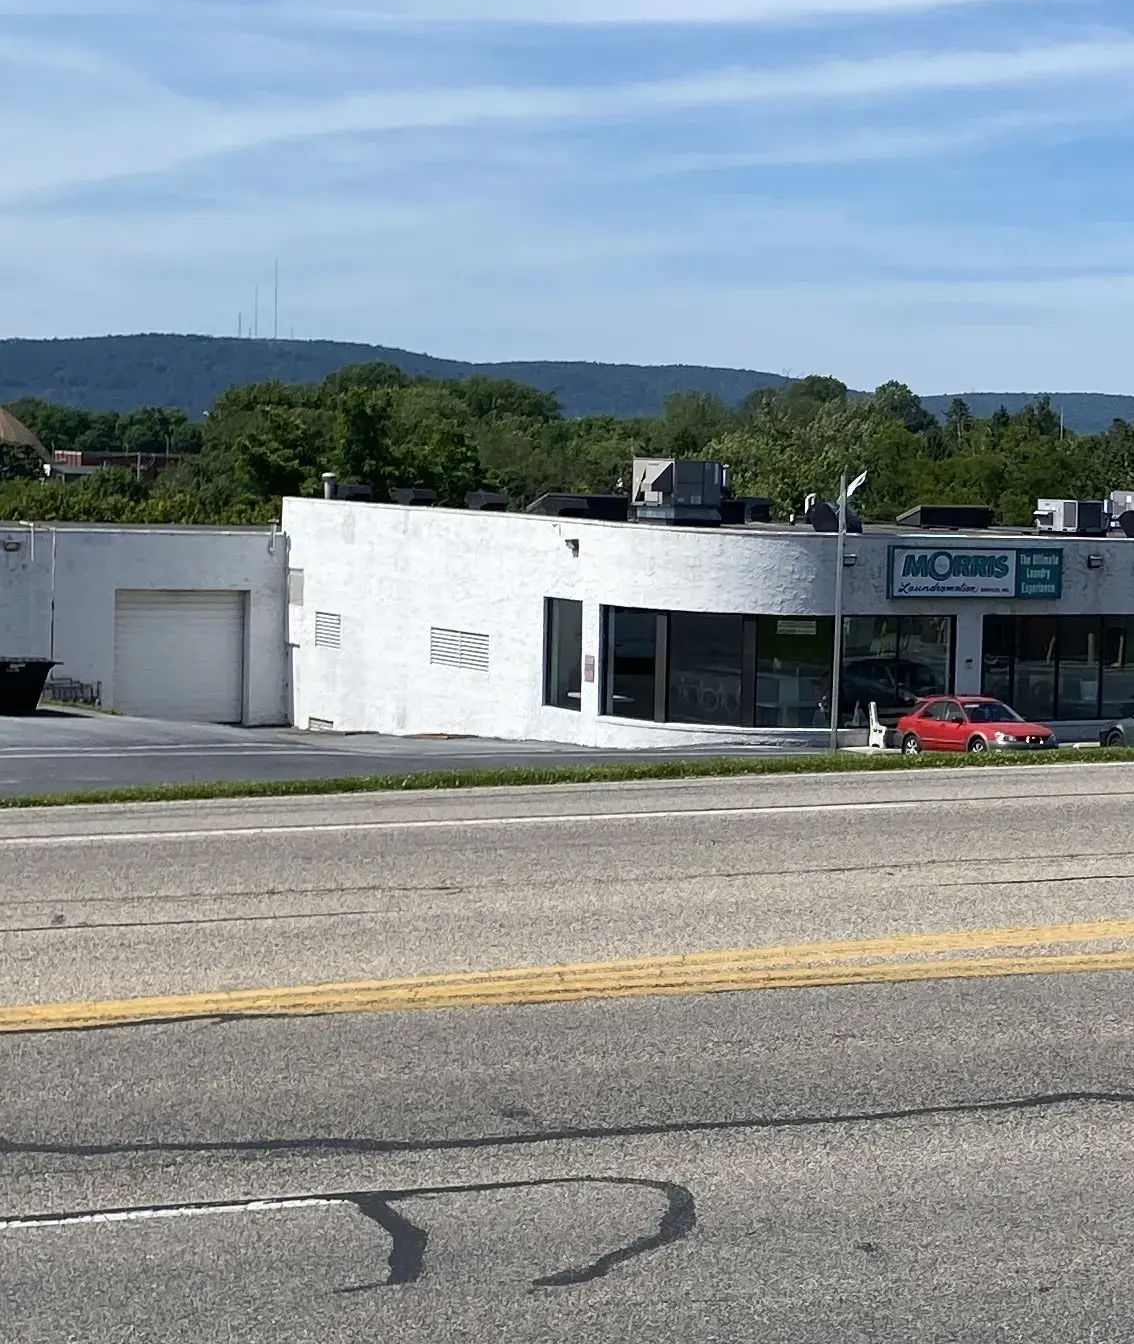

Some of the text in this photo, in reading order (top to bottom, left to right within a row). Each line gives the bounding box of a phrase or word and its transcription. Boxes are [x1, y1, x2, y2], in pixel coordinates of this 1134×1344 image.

[902, 551, 1009, 581] MORRIS
[1020, 554, 1031, 565] The
[1026, 567, 1051, 580] Laundry
[1021, 582, 1055, 595] Experience
